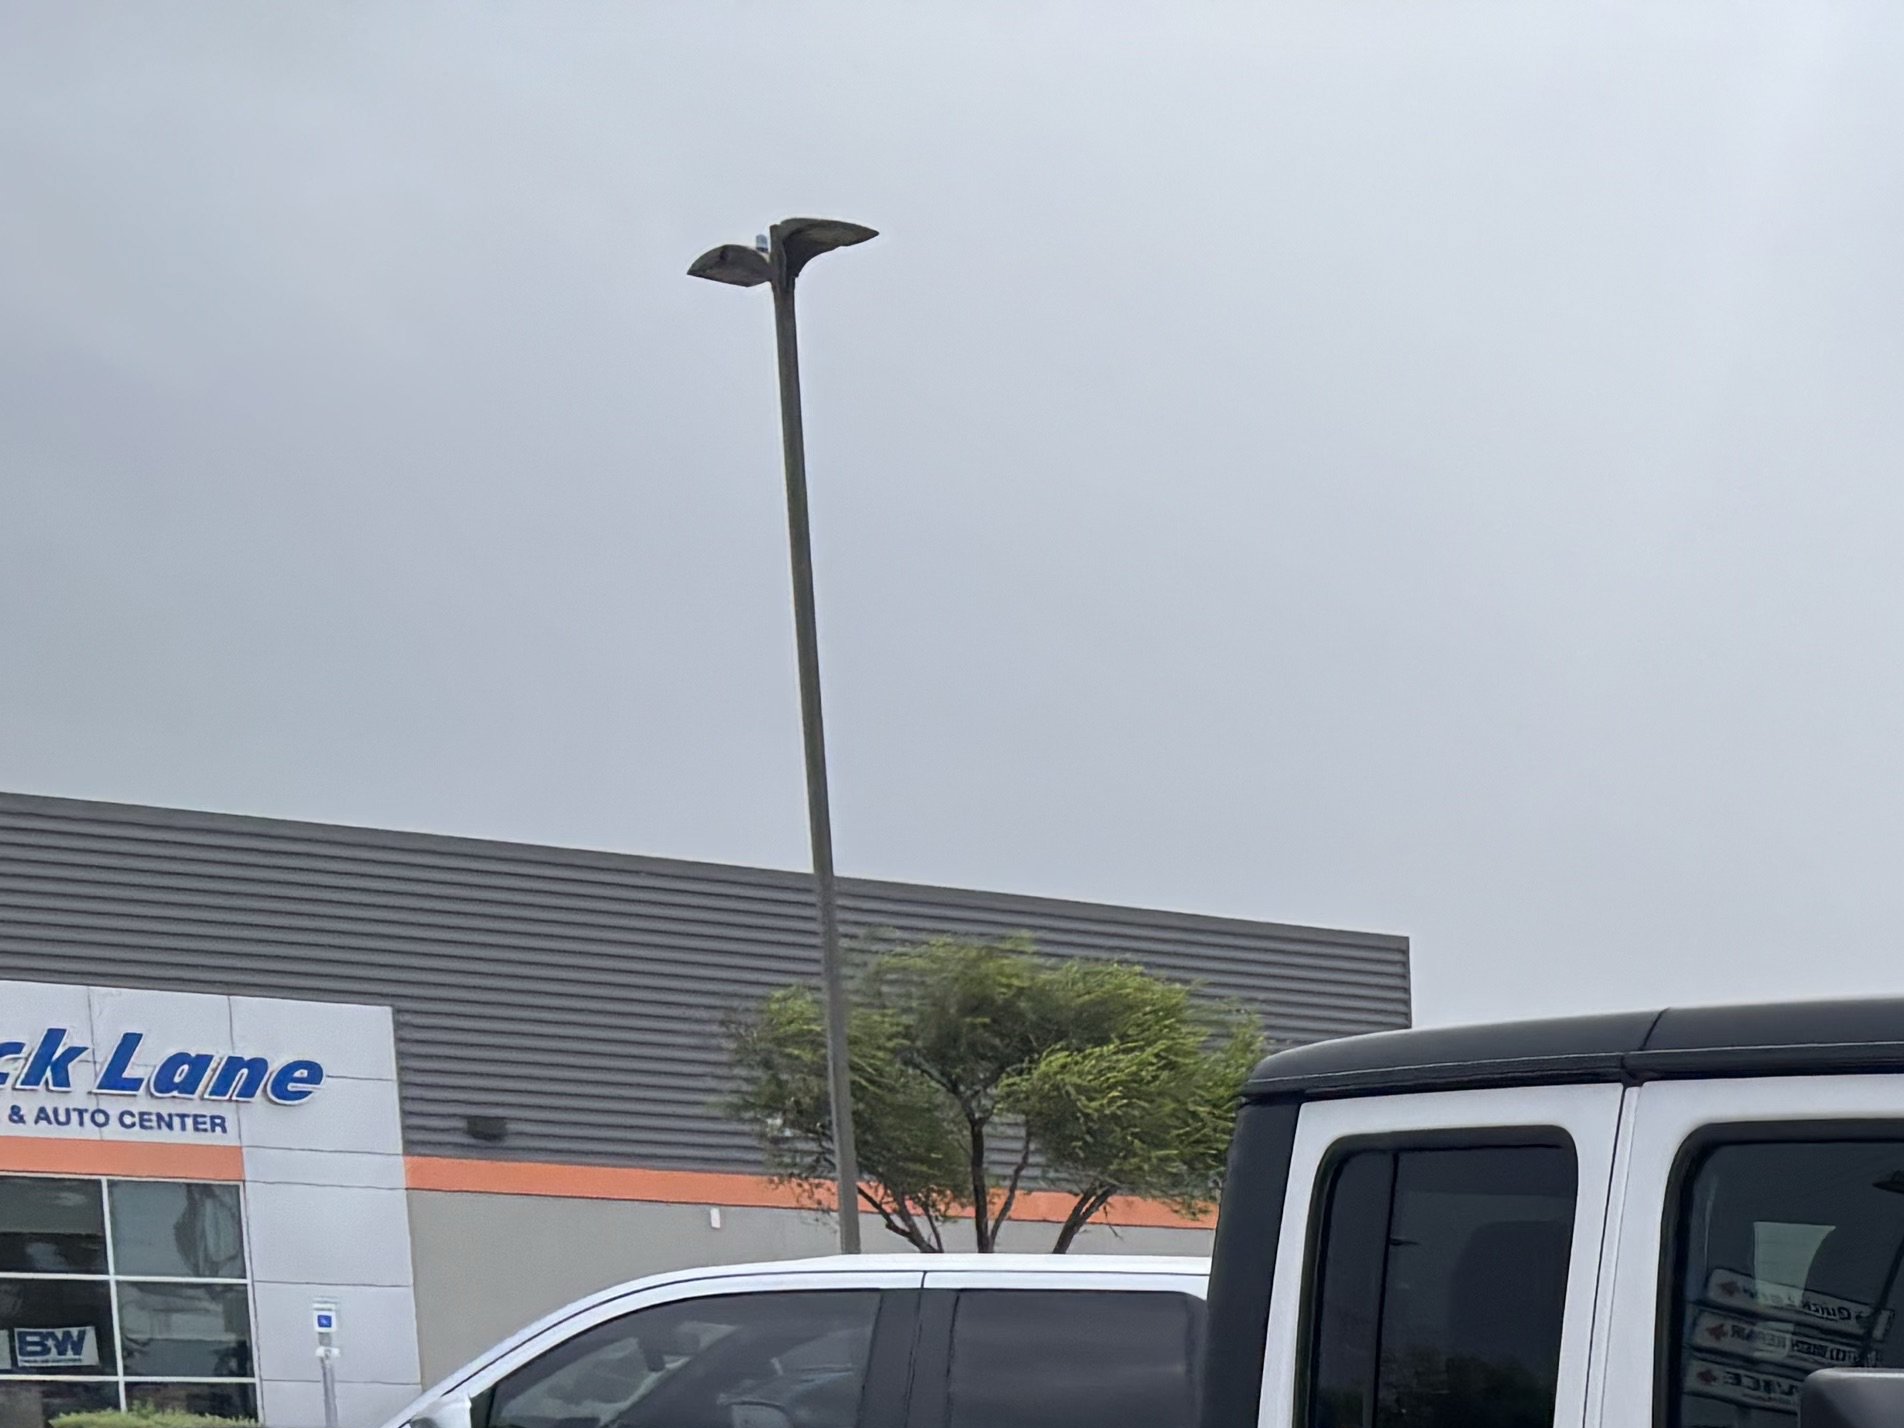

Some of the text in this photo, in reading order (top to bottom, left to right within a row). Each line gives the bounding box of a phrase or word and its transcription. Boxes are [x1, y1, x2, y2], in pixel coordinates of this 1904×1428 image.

[90, 1031, 325, 1105] Lane
[8, 1105, 229, 1134] & AUTO CENTER
